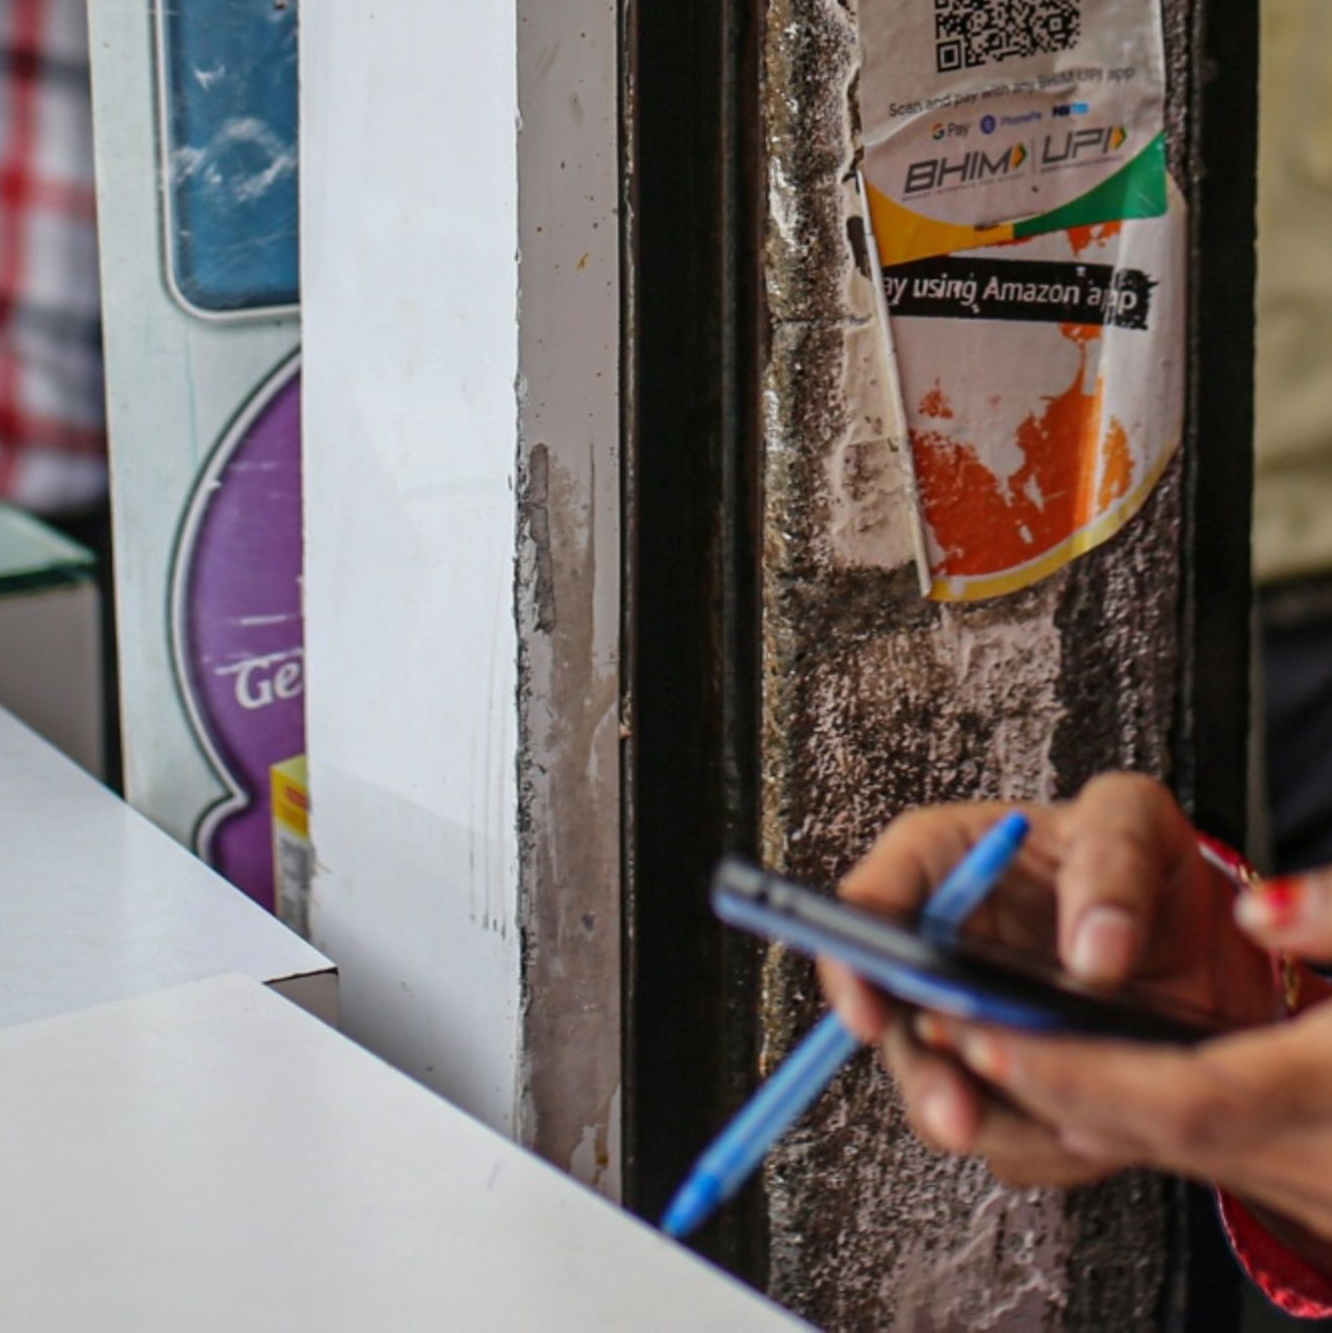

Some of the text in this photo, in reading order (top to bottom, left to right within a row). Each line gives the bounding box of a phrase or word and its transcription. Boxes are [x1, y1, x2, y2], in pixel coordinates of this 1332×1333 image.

[889, 101, 923, 118] Scan
[926, 96, 951, 110] and
[954, 92, 977, 108] pay
[980, 84, 1010, 99] with
[1012, 81, 1035, 96] any
[1077, 67, 1104, 81] UPI
[1107, 67, 1136, 83] app
[947, 122, 970, 138] Pay
[904, 146, 1013, 195] BHIM
[1042, 127, 1117, 164] UPI
[912, 273, 977, 307] using
[983, 276, 1080, 305] Amazon
[1087, 283, 1138, 316] app
